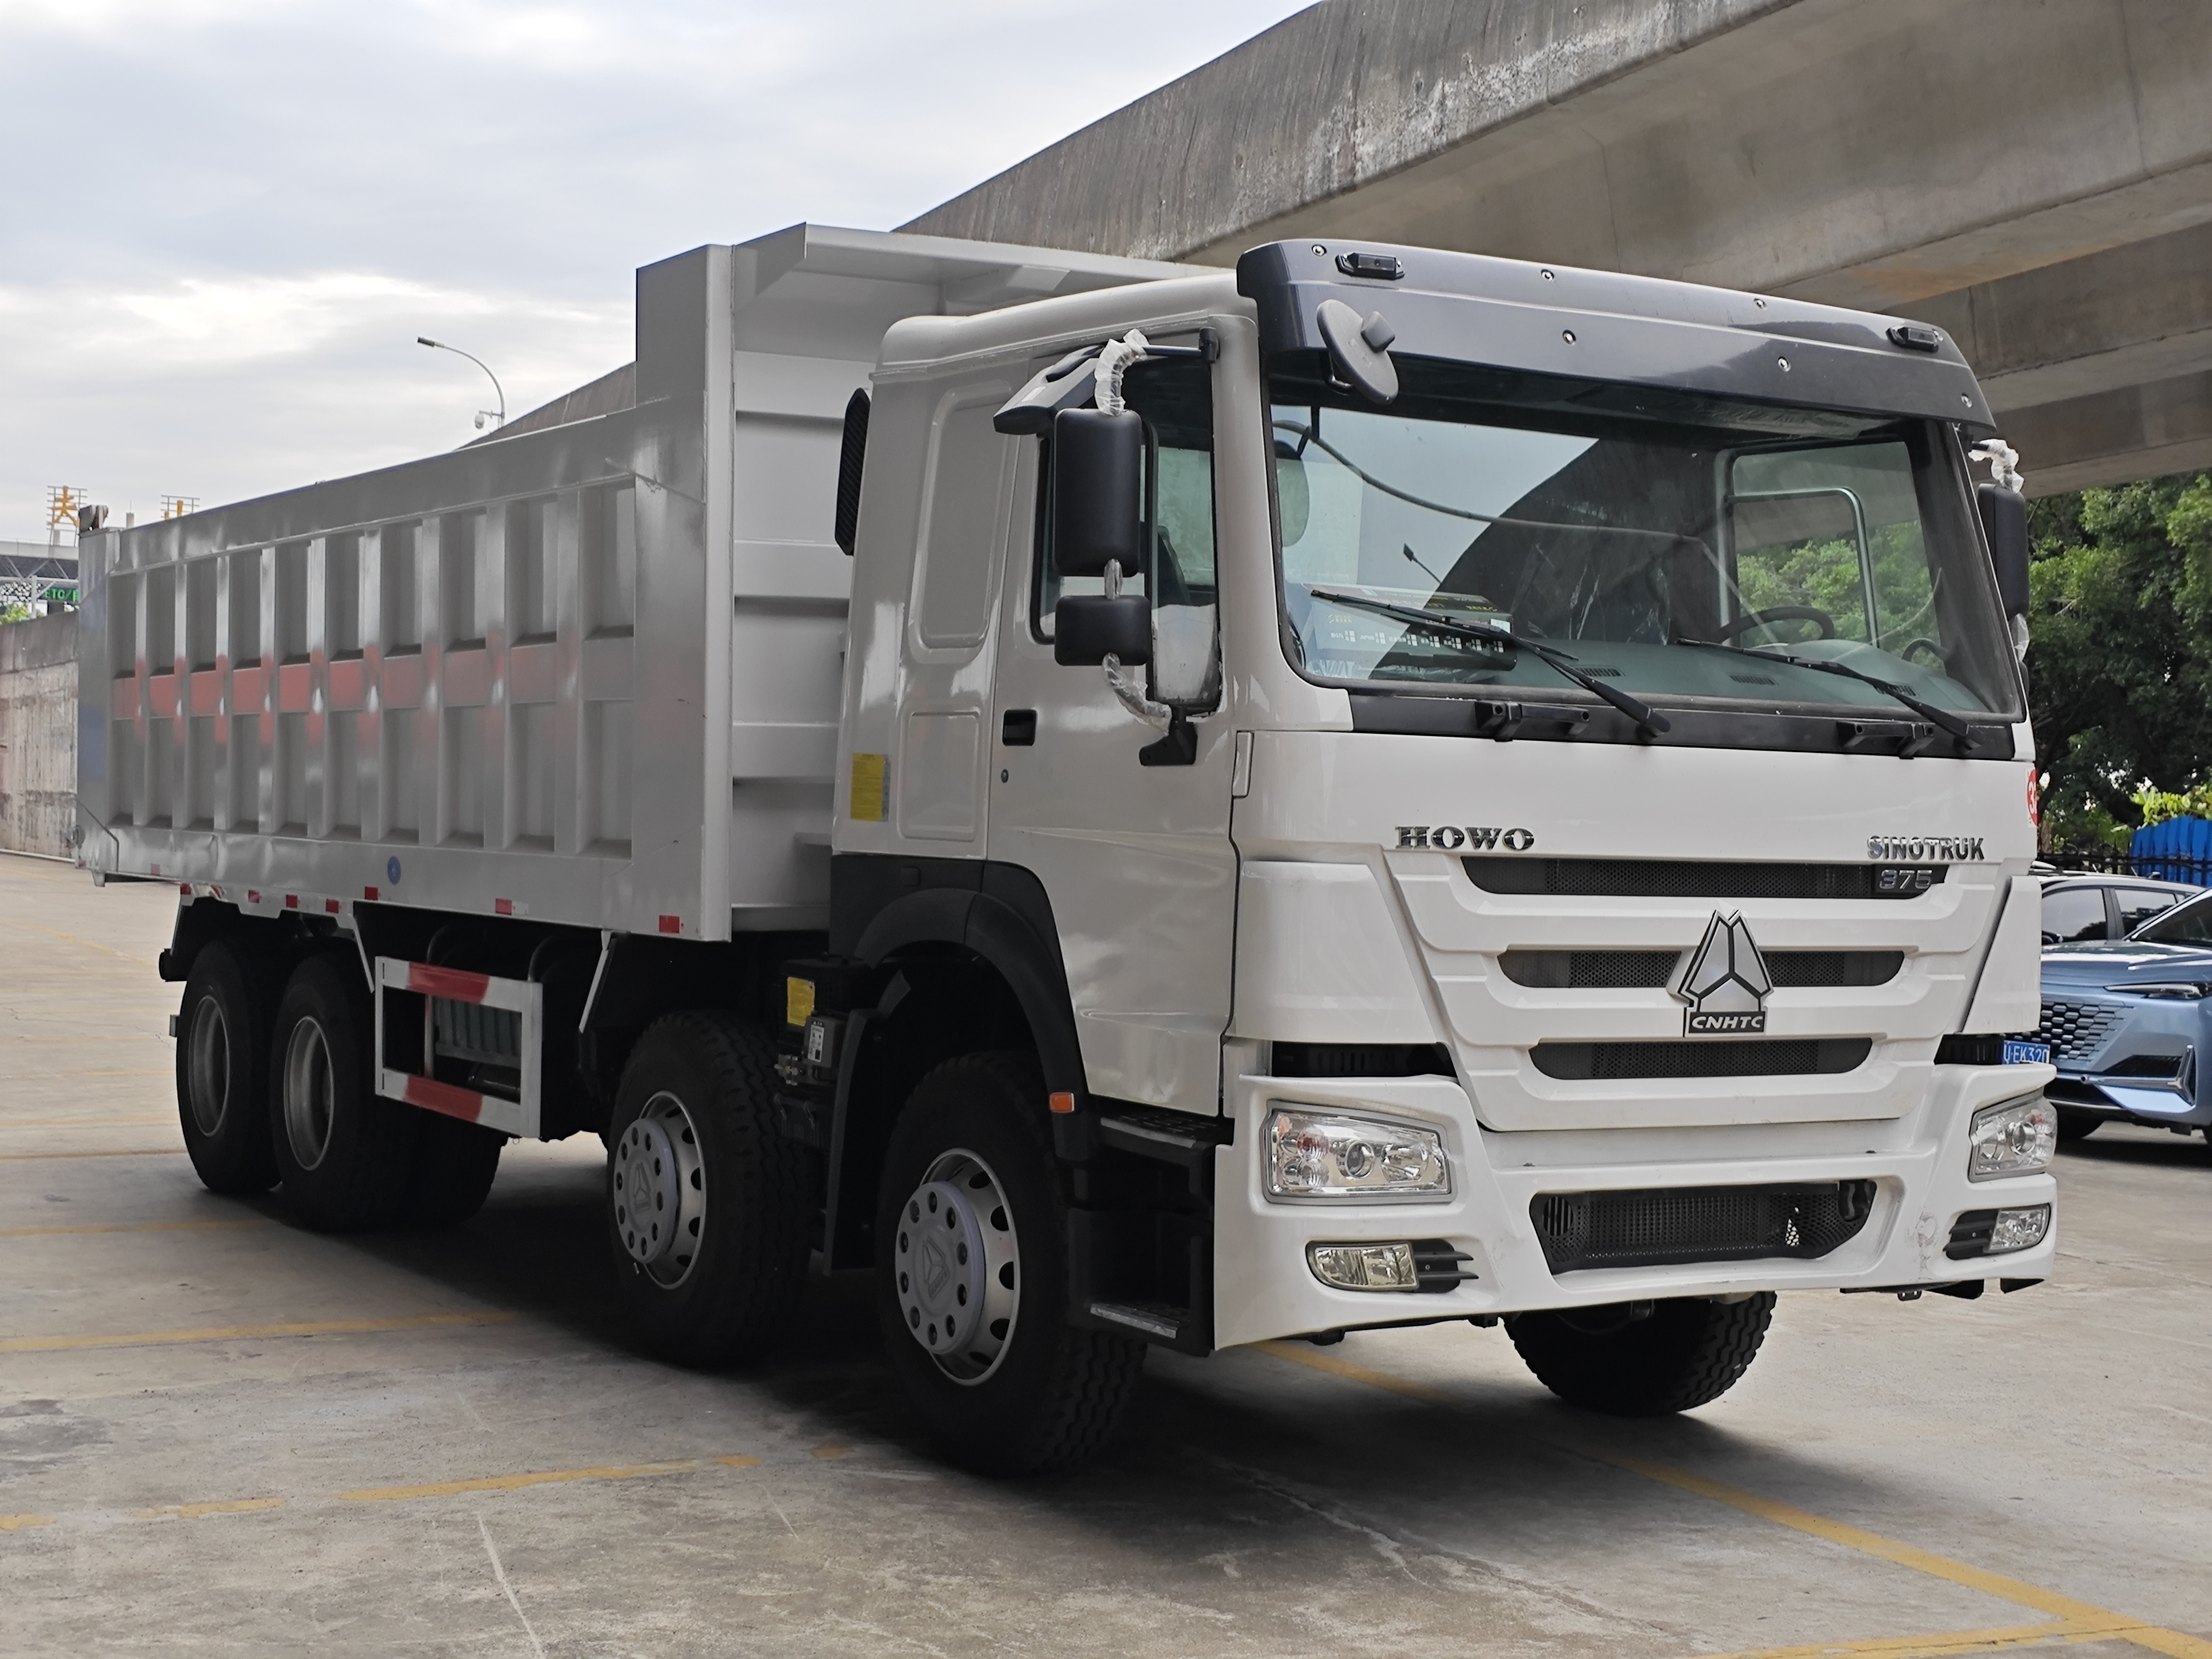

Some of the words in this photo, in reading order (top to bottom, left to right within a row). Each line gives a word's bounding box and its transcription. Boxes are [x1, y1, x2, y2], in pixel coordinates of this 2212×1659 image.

[2028, 781, 2037, 815] 3
[1395, 826, 1535, 851] HOWO
[1867, 835, 1985, 860] SINOTRUK
[1879, 869, 1933, 889] 375
[1691, 1016, 1763, 1029] CNHTC
